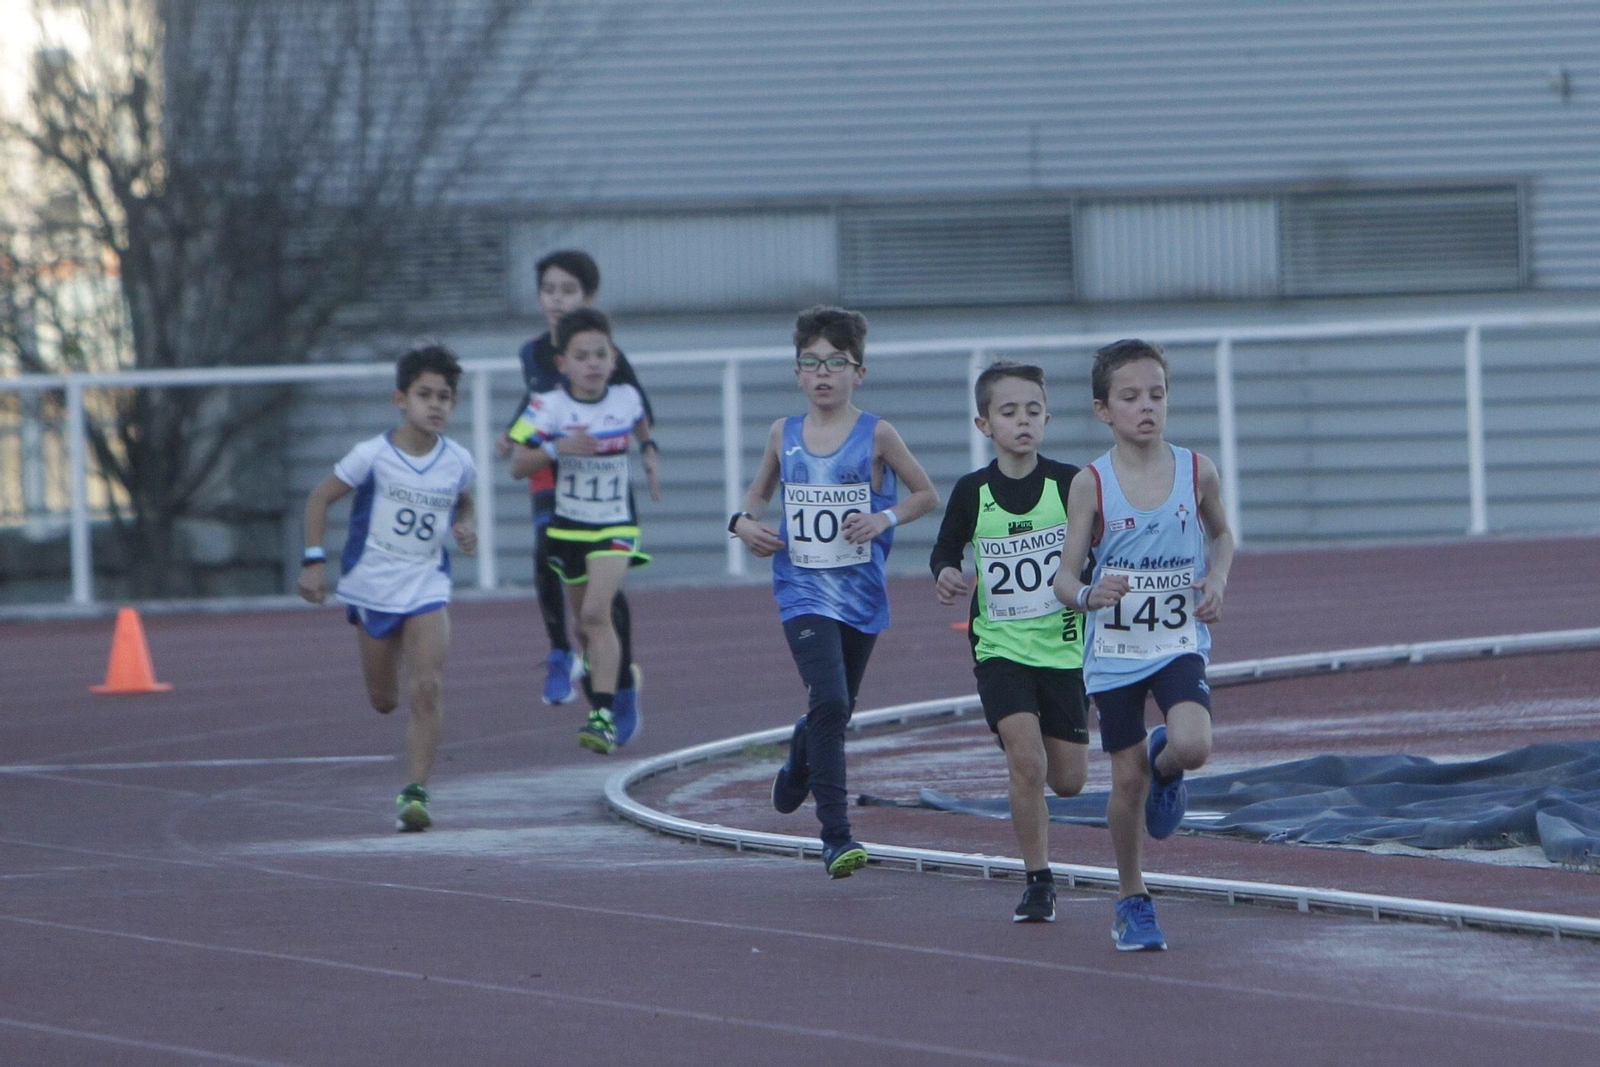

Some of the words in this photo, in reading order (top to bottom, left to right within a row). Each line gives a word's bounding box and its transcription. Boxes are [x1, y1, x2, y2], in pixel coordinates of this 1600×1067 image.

[388, 485, 453, 508] VOLTAMOS
[561, 472, 623, 502] 111
[787, 488, 867, 503] VOLTAMOS
[392, 507, 436, 541] 98
[981, 528, 1066, 555] VOLTAMOS
[988, 550, 1062, 595] 202
[1104, 572, 1191, 590] TAMOS
[1104, 594, 1187, 632] 143
